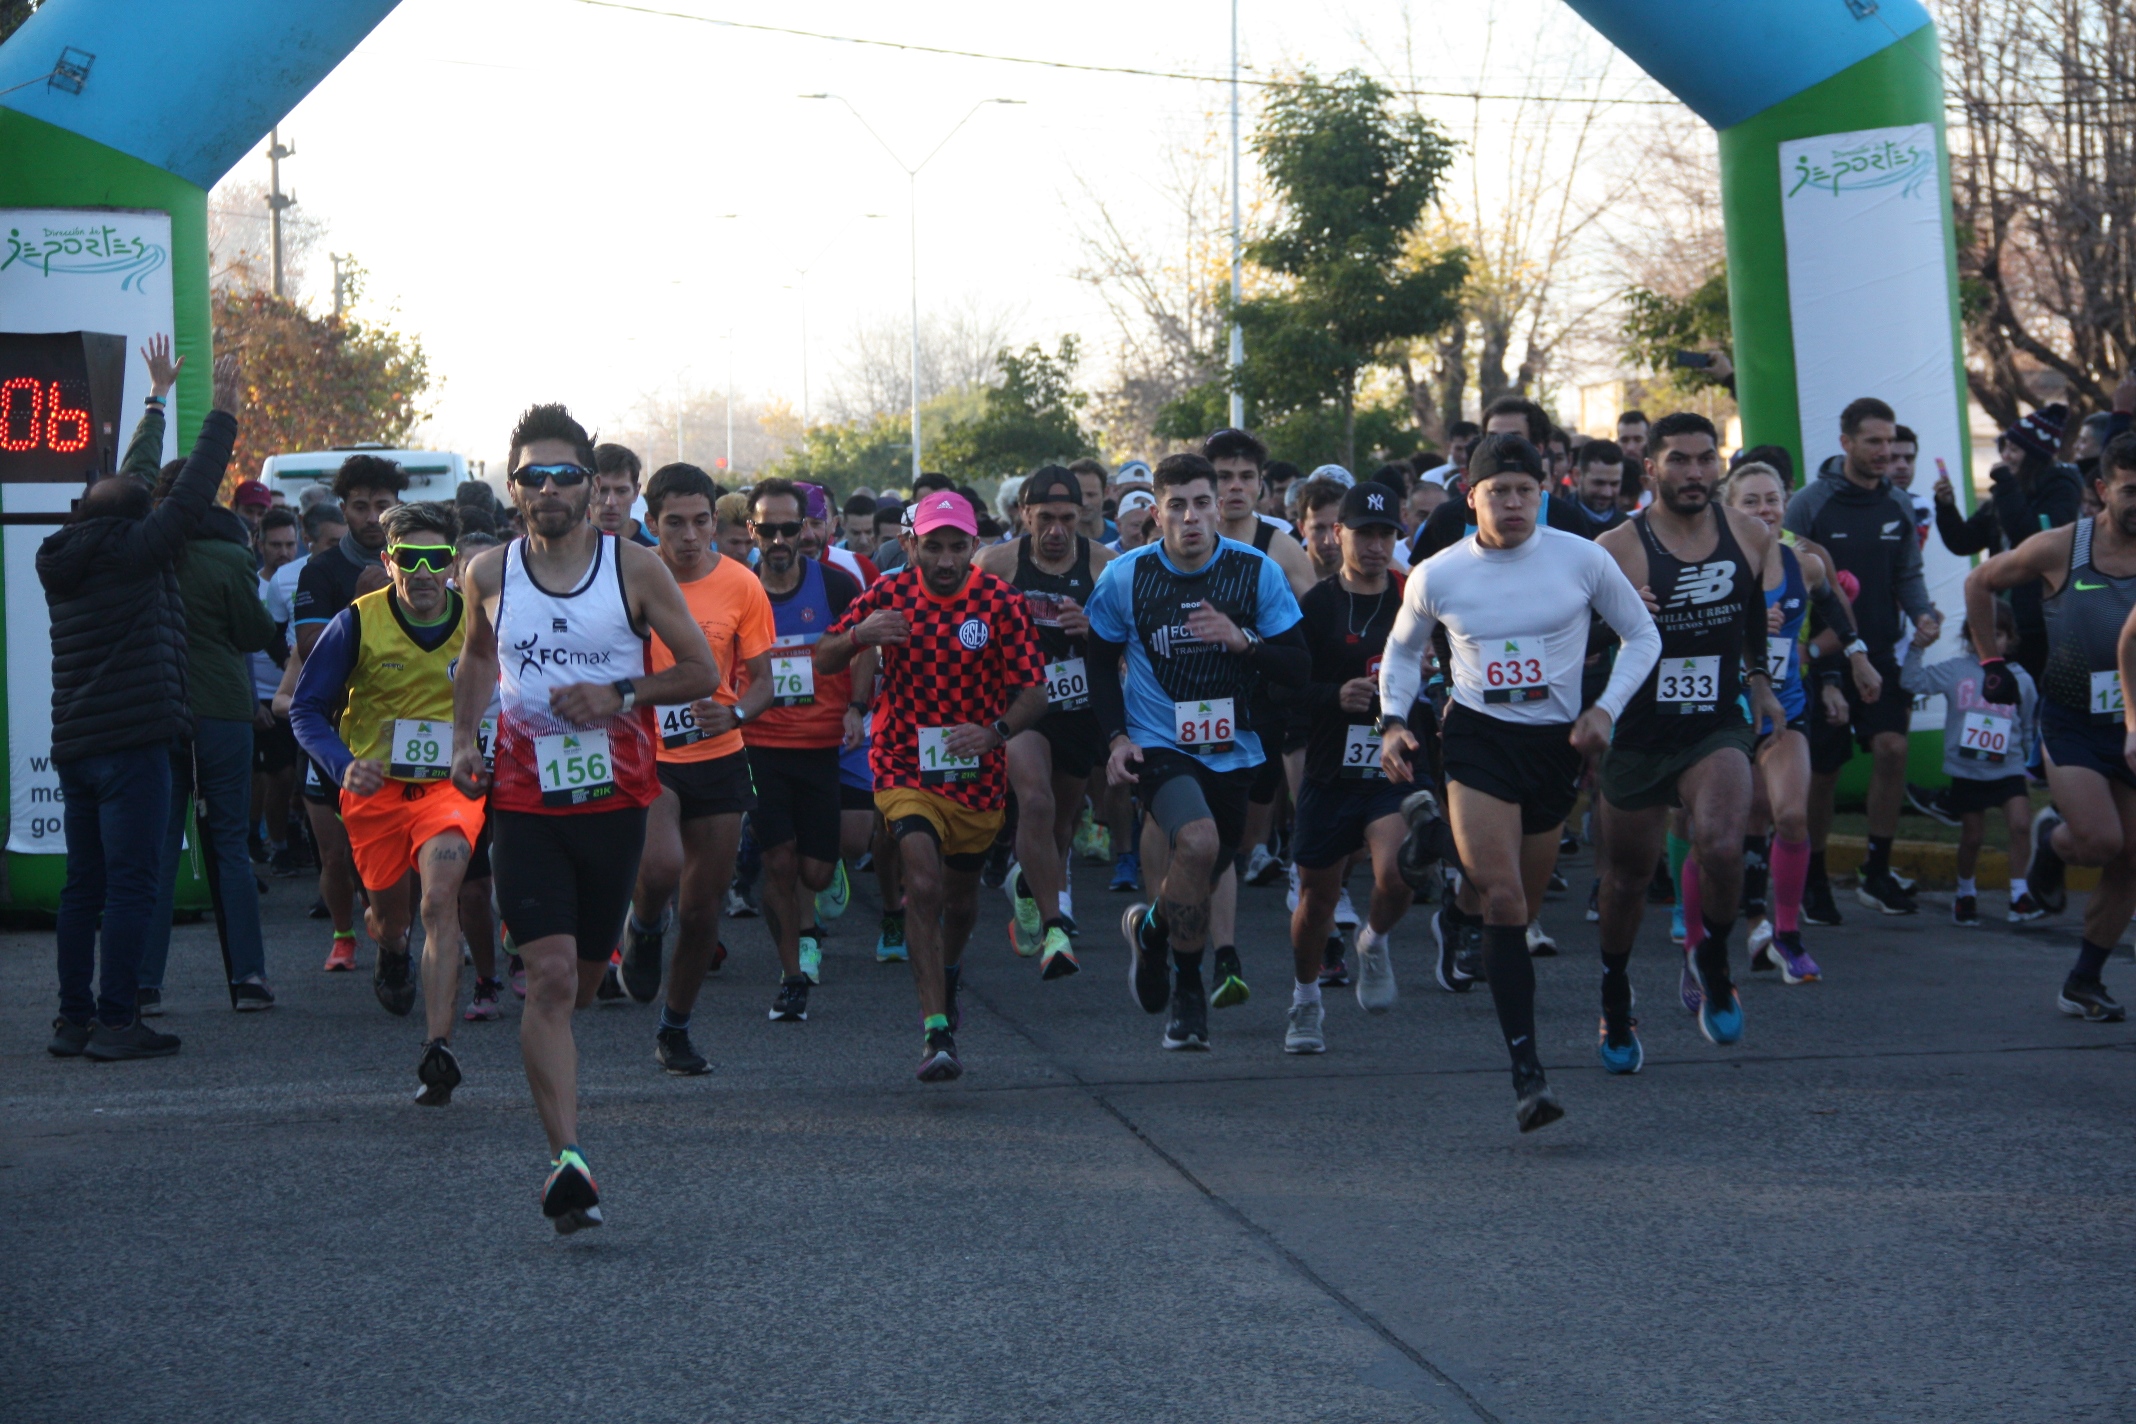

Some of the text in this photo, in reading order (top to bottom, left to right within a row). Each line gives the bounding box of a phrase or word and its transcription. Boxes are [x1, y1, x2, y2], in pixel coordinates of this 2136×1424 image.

[1367, 493, 1384, 511] NY
[1666, 616, 1733, 631] BUENOS AIRES
[1174, 645, 1219, 655] TRAINING
[1487, 658, 1542, 687] 633
[1047, 674, 1084, 699] 460
[1662, 675, 1713, 698] 333
[1697, 704, 1715, 712] 10K
[2097, 688, 2125, 710] 12
[664, 707, 696, 732] 46
[1181, 718, 1231, 742] 816
[405, 739, 439, 763] 89
[1967, 728, 2004, 751] 700
[1348, 743, 1380, 764] 37
[545, 753, 607, 787] 156
